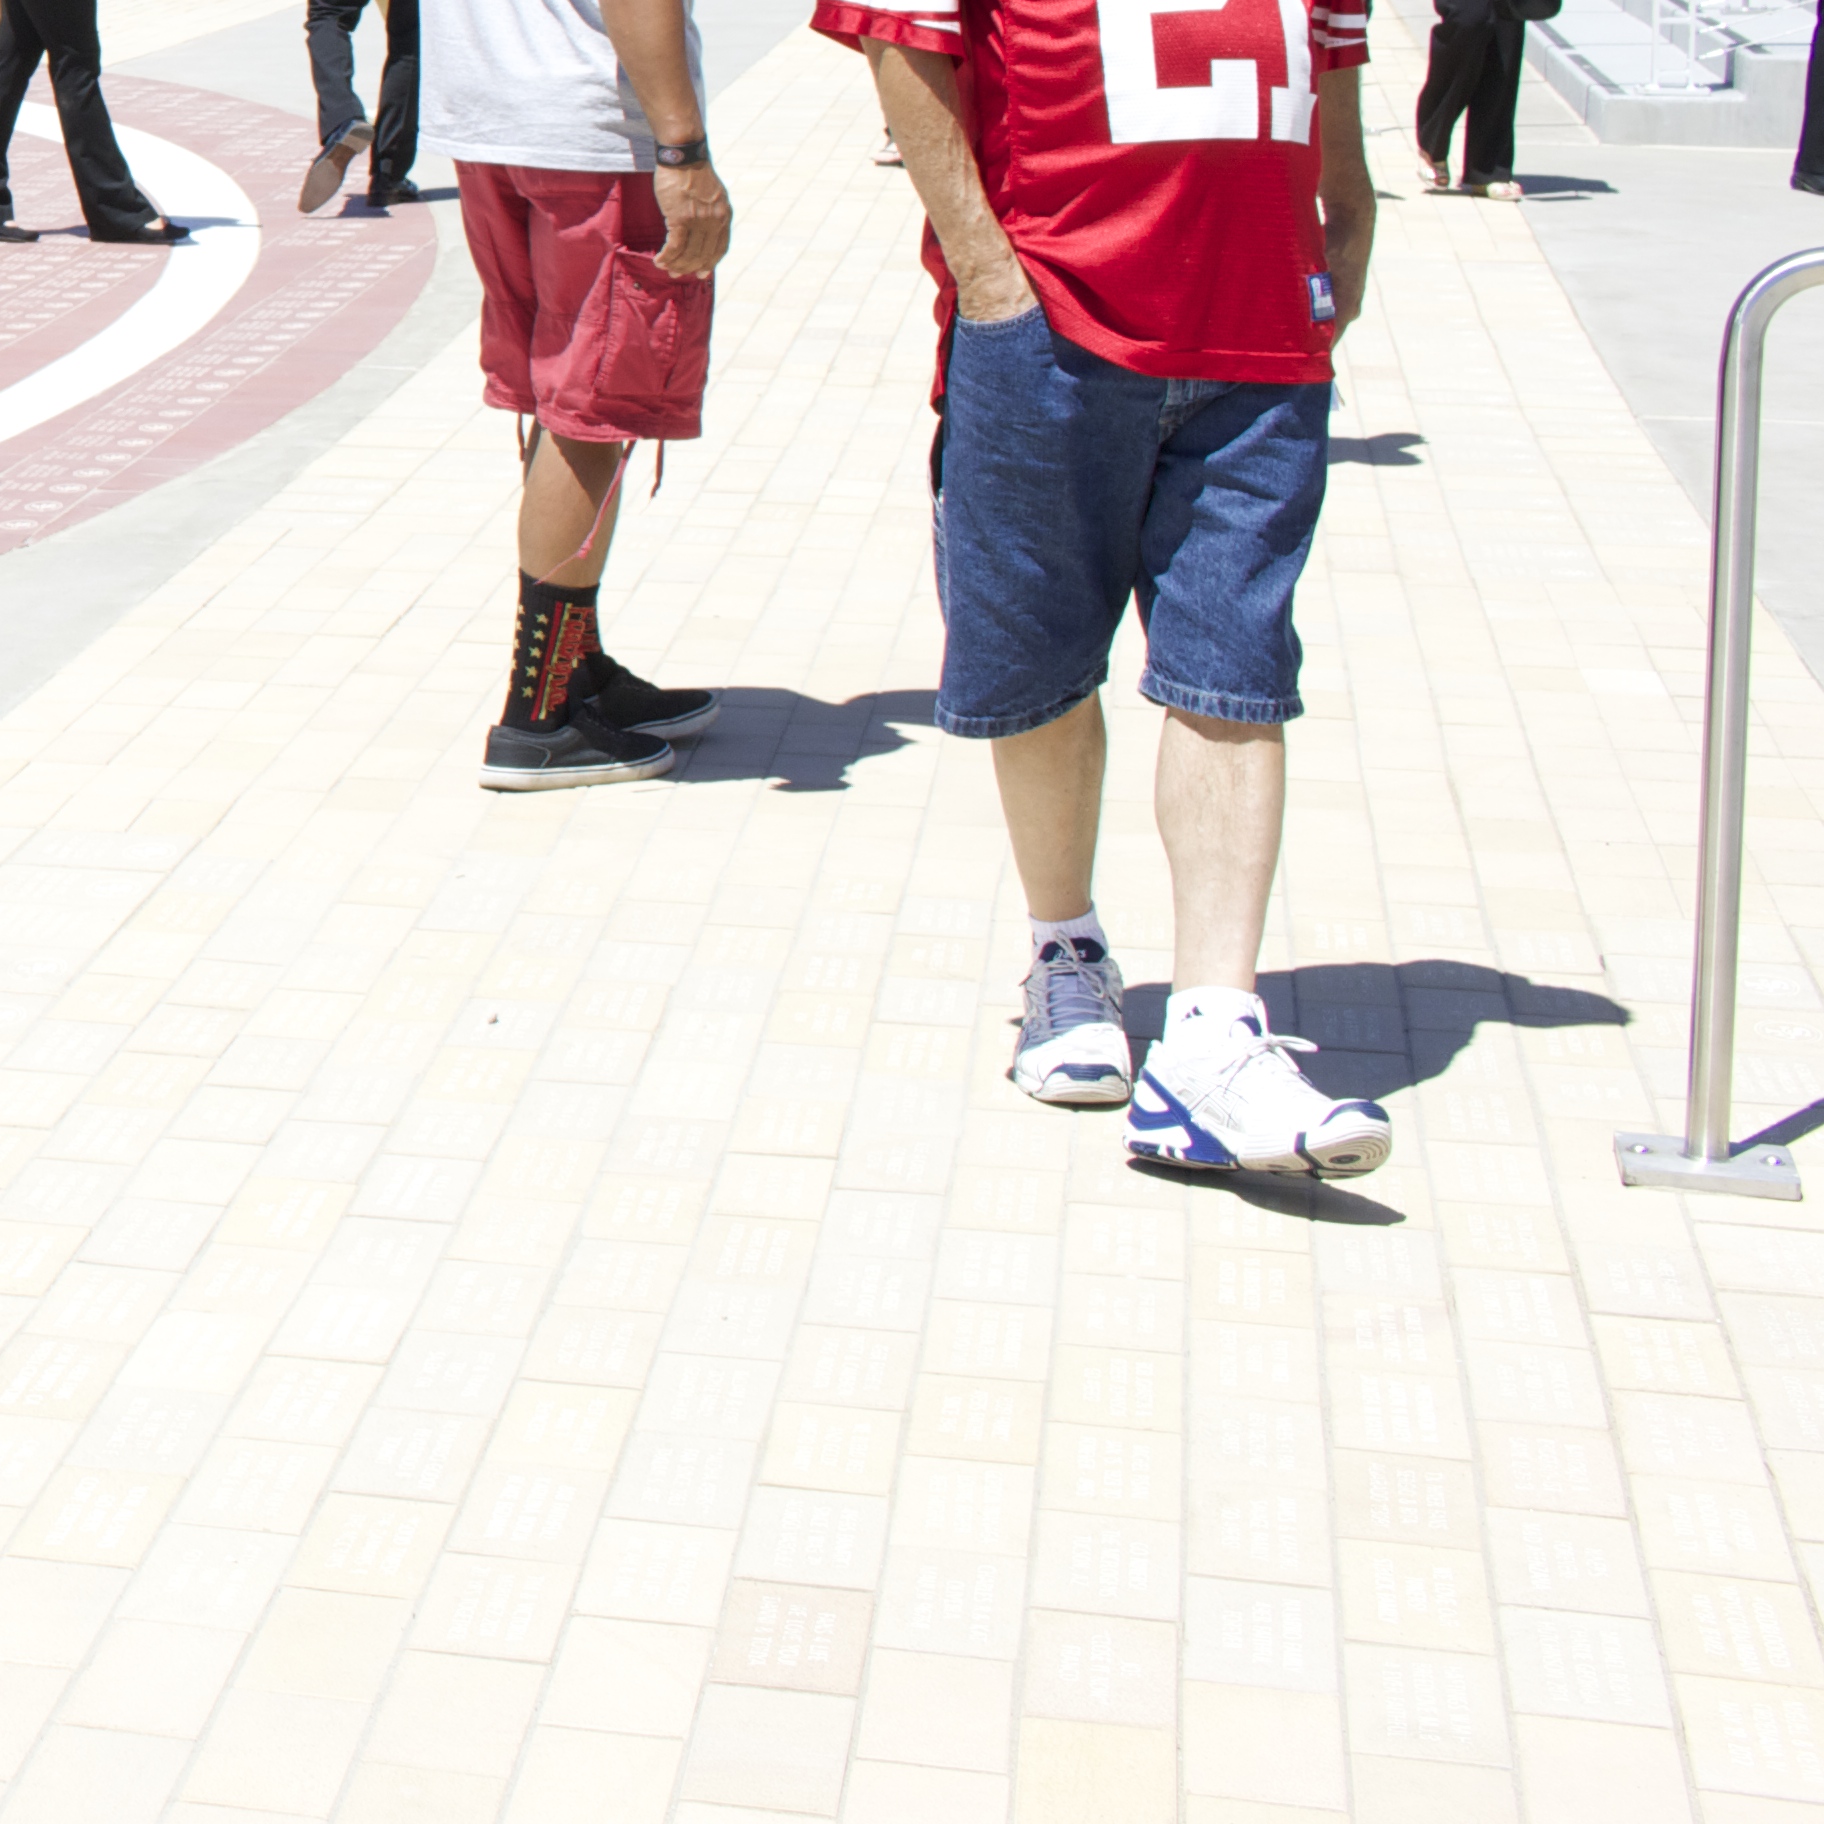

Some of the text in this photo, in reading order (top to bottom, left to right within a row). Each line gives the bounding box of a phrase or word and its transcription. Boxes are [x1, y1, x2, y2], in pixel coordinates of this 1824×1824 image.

[1100, 1530, 1121, 1546] THE
[1375, 1593, 1399, 1625] FAMILY
[1435, 1582, 1457, 1605] LOVE
[782, 1620, 805, 1641] LOVE
[815, 1612, 836, 1636] FANS
[1222, 1610, 1242, 1649] FOREVER
[1439, 1608, 1459, 1628] OUR
[807, 1644, 830, 1662] LIFE
[1251, 1626, 1272, 1664] FAITHFUL
[1282, 1642, 1304, 1674] FAMILY
[1537, 1621, 1562, 1678] HUTCHINSON
[1381, 1671, 1404, 1695] EVER
[1574, 1664, 1601, 1704] GEORGIA
[1608, 1673, 1633, 1706] ROBYN
[1383, 1696, 1407, 1738] FAITHFUL
